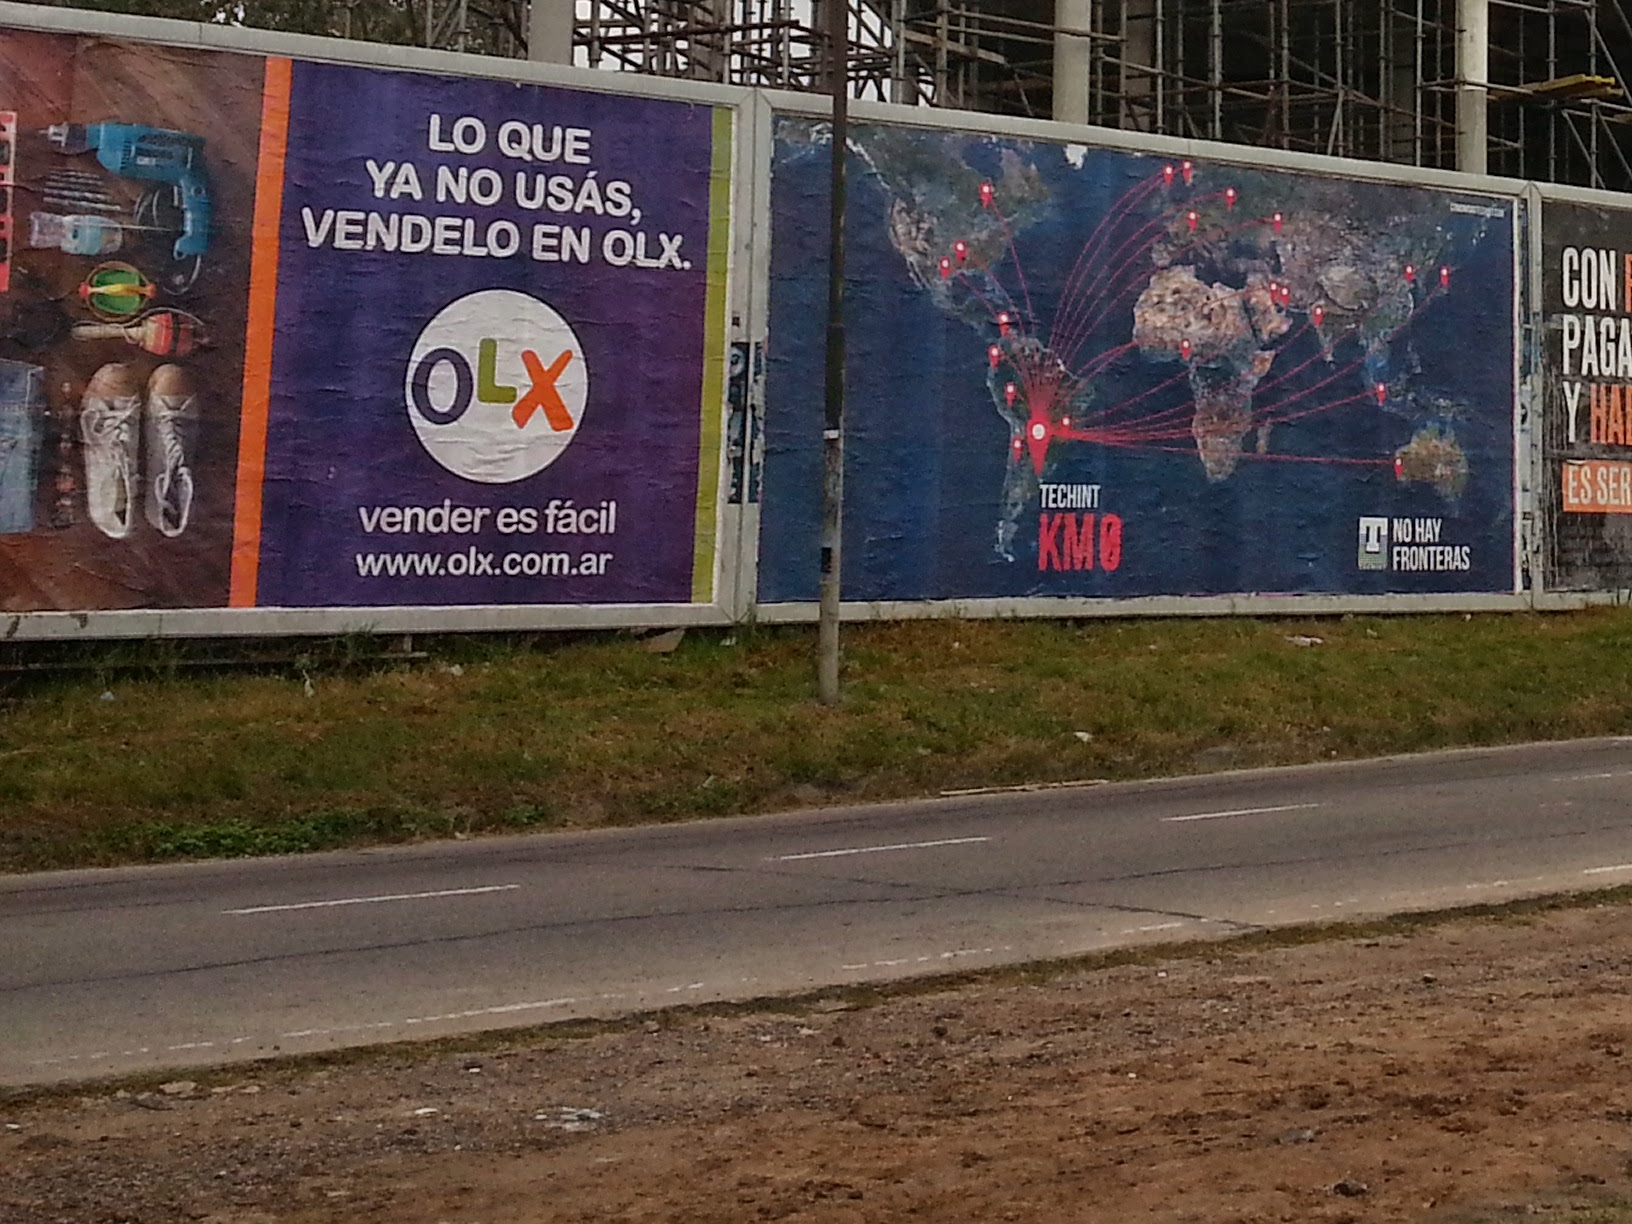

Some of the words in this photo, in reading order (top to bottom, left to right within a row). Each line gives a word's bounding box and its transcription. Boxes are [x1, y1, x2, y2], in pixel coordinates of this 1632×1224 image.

[429, 114, 486, 154] LO
[499, 121, 591, 164] QUE
[366, 159, 422, 201] YA
[436, 166, 501, 206] NO
[516, 171, 641, 225] USÁS,
[302, 207, 520, 257] VENDELO
[532, 225, 590, 263] EN
[603, 230, 691, 270] OLX.
[1562, 247, 1616, 310] CON
[412, 338, 574, 431] OLX
[1563, 381, 1580, 443] Y
[1039, 484, 1101, 508] TECHINT
[1568, 465, 1592, 504] ES
[1597, 466, 1631, 505] SER
[359, 499, 490, 533] vender
[497, 506, 537, 533] es
[545, 499, 616, 533] fácil
[1393, 518, 1412, 542] NO
[1415, 518, 1442, 542] HAY
[356, 546, 613, 576] www.olx.com.ar
[1039, 513, 1094, 570] KM
[1393, 546, 1470, 570] FRONTERAS
